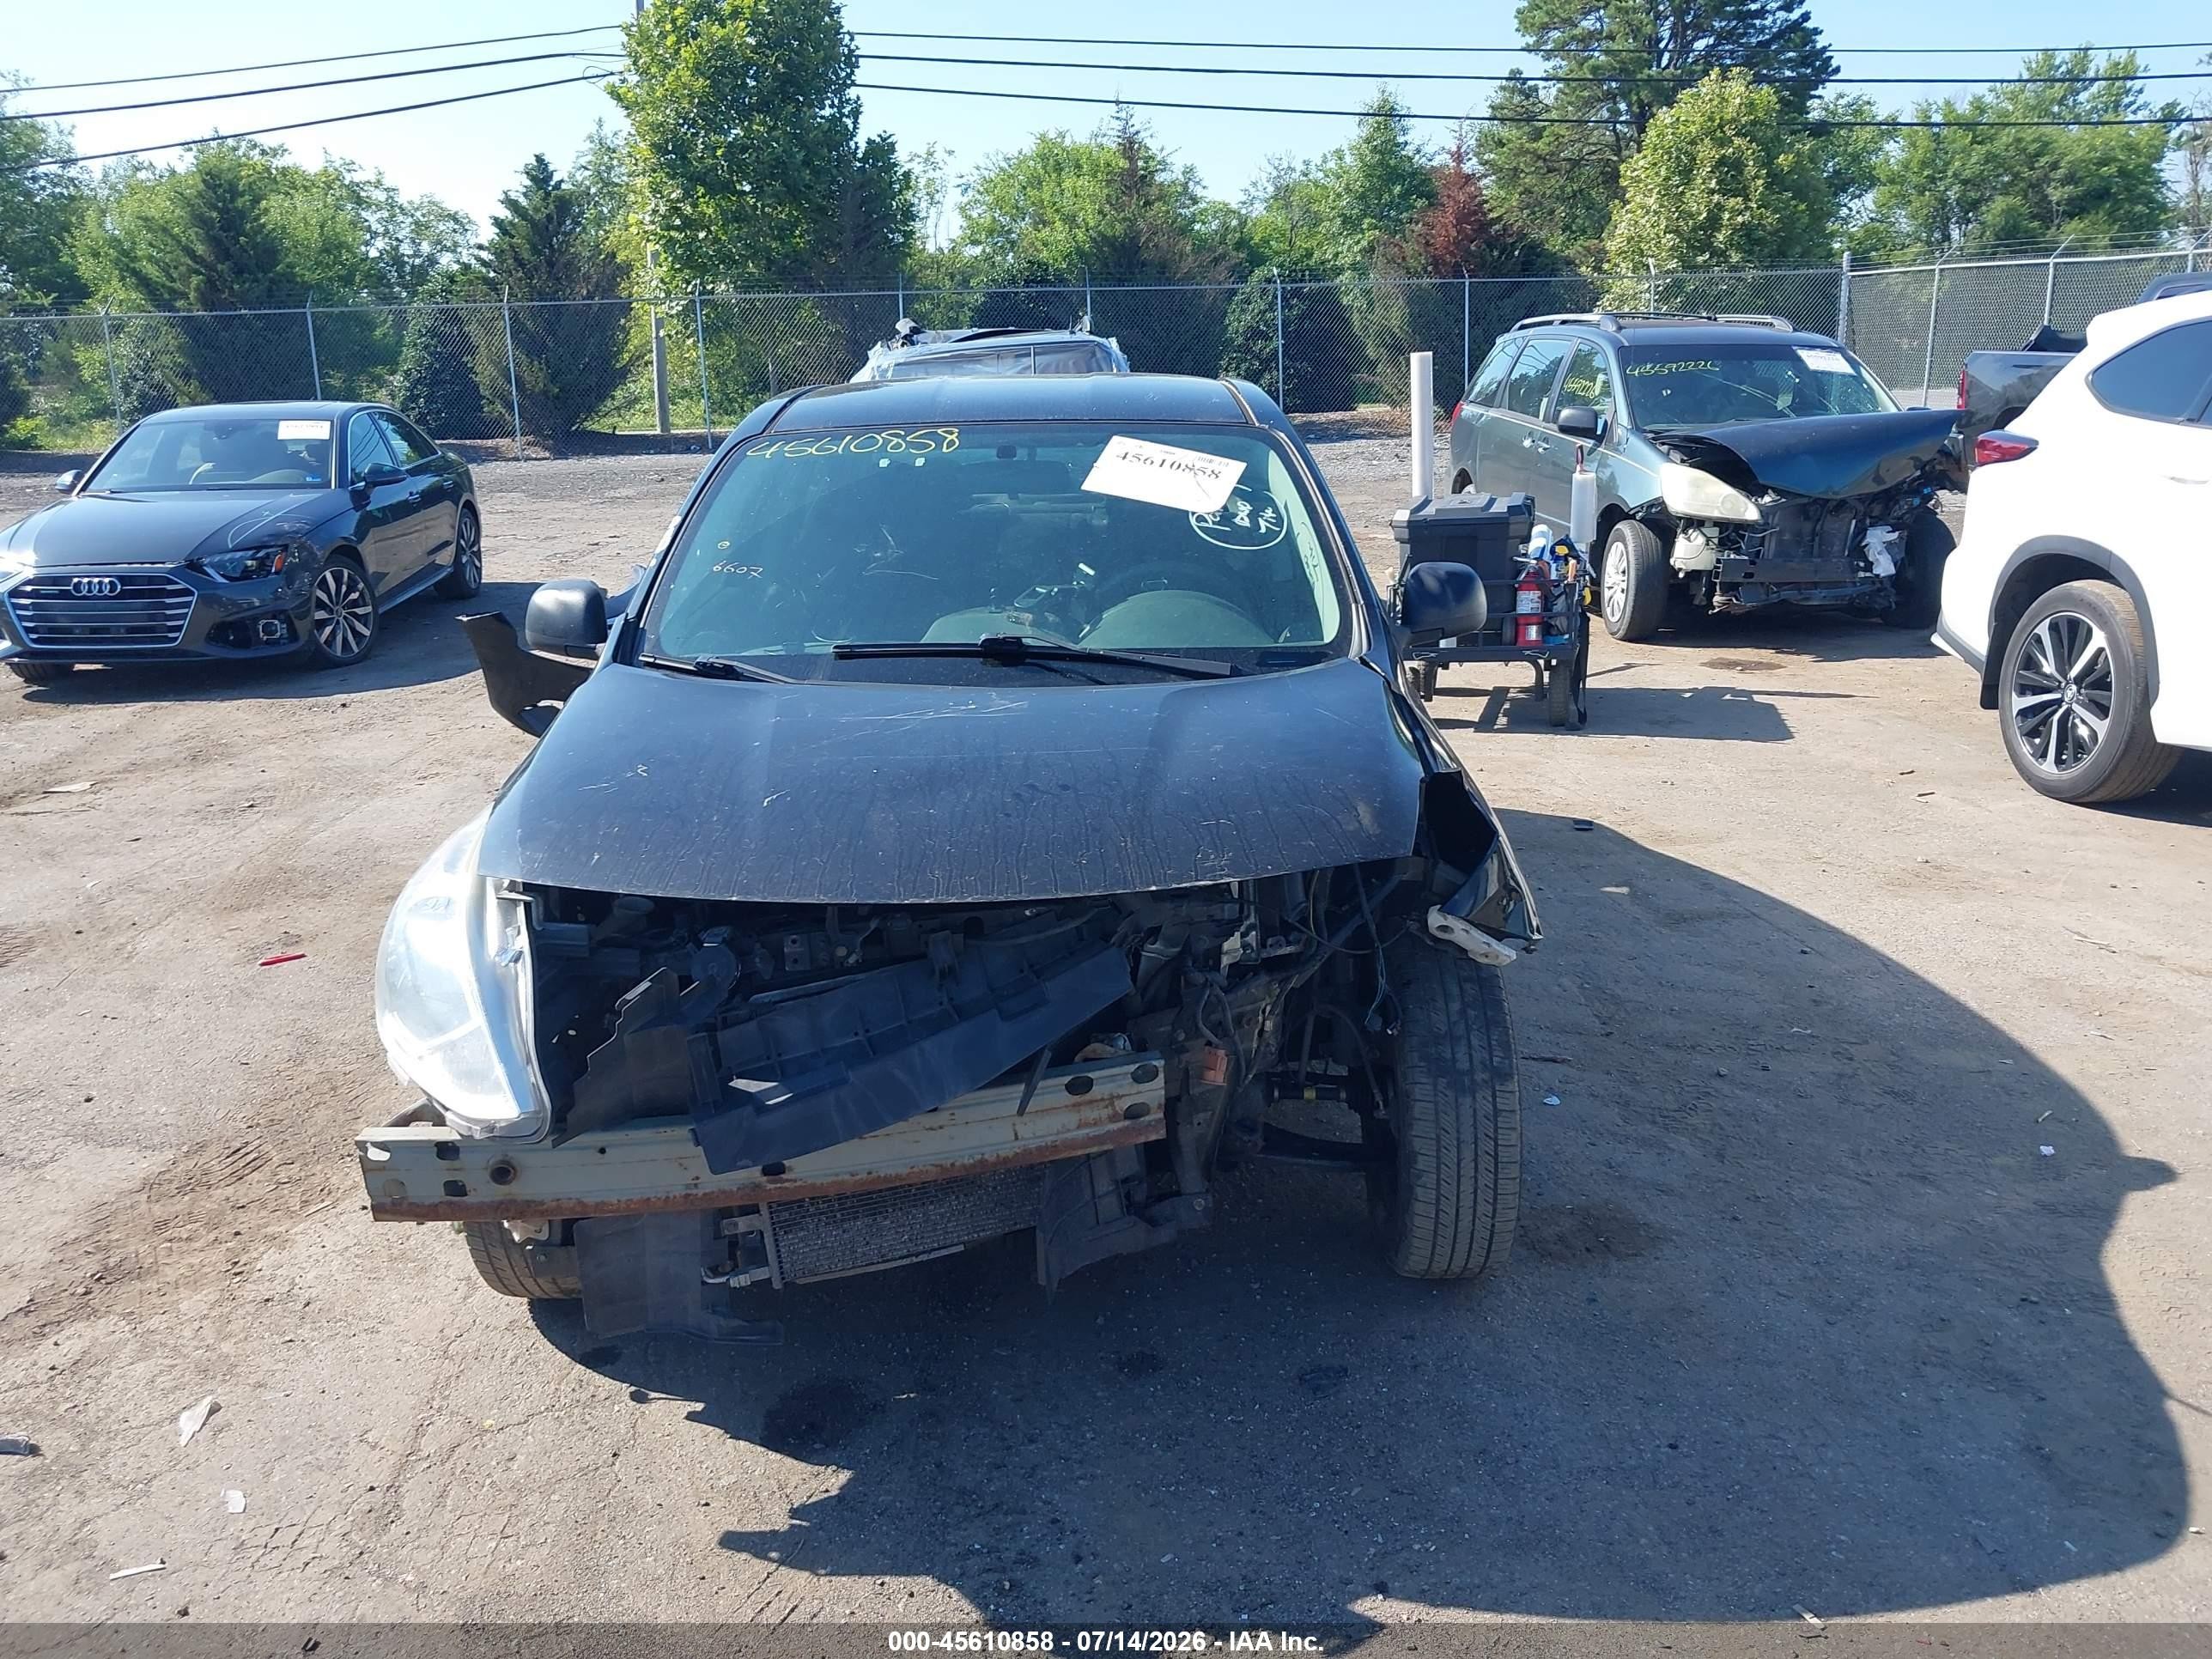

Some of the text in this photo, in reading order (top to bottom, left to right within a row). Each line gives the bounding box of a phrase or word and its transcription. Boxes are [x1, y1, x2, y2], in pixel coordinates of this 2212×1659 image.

[746, 428, 960, 459] 45610858
[1115, 451, 1222, 480] 45610858
[713, 560, 763, 580] 6607
